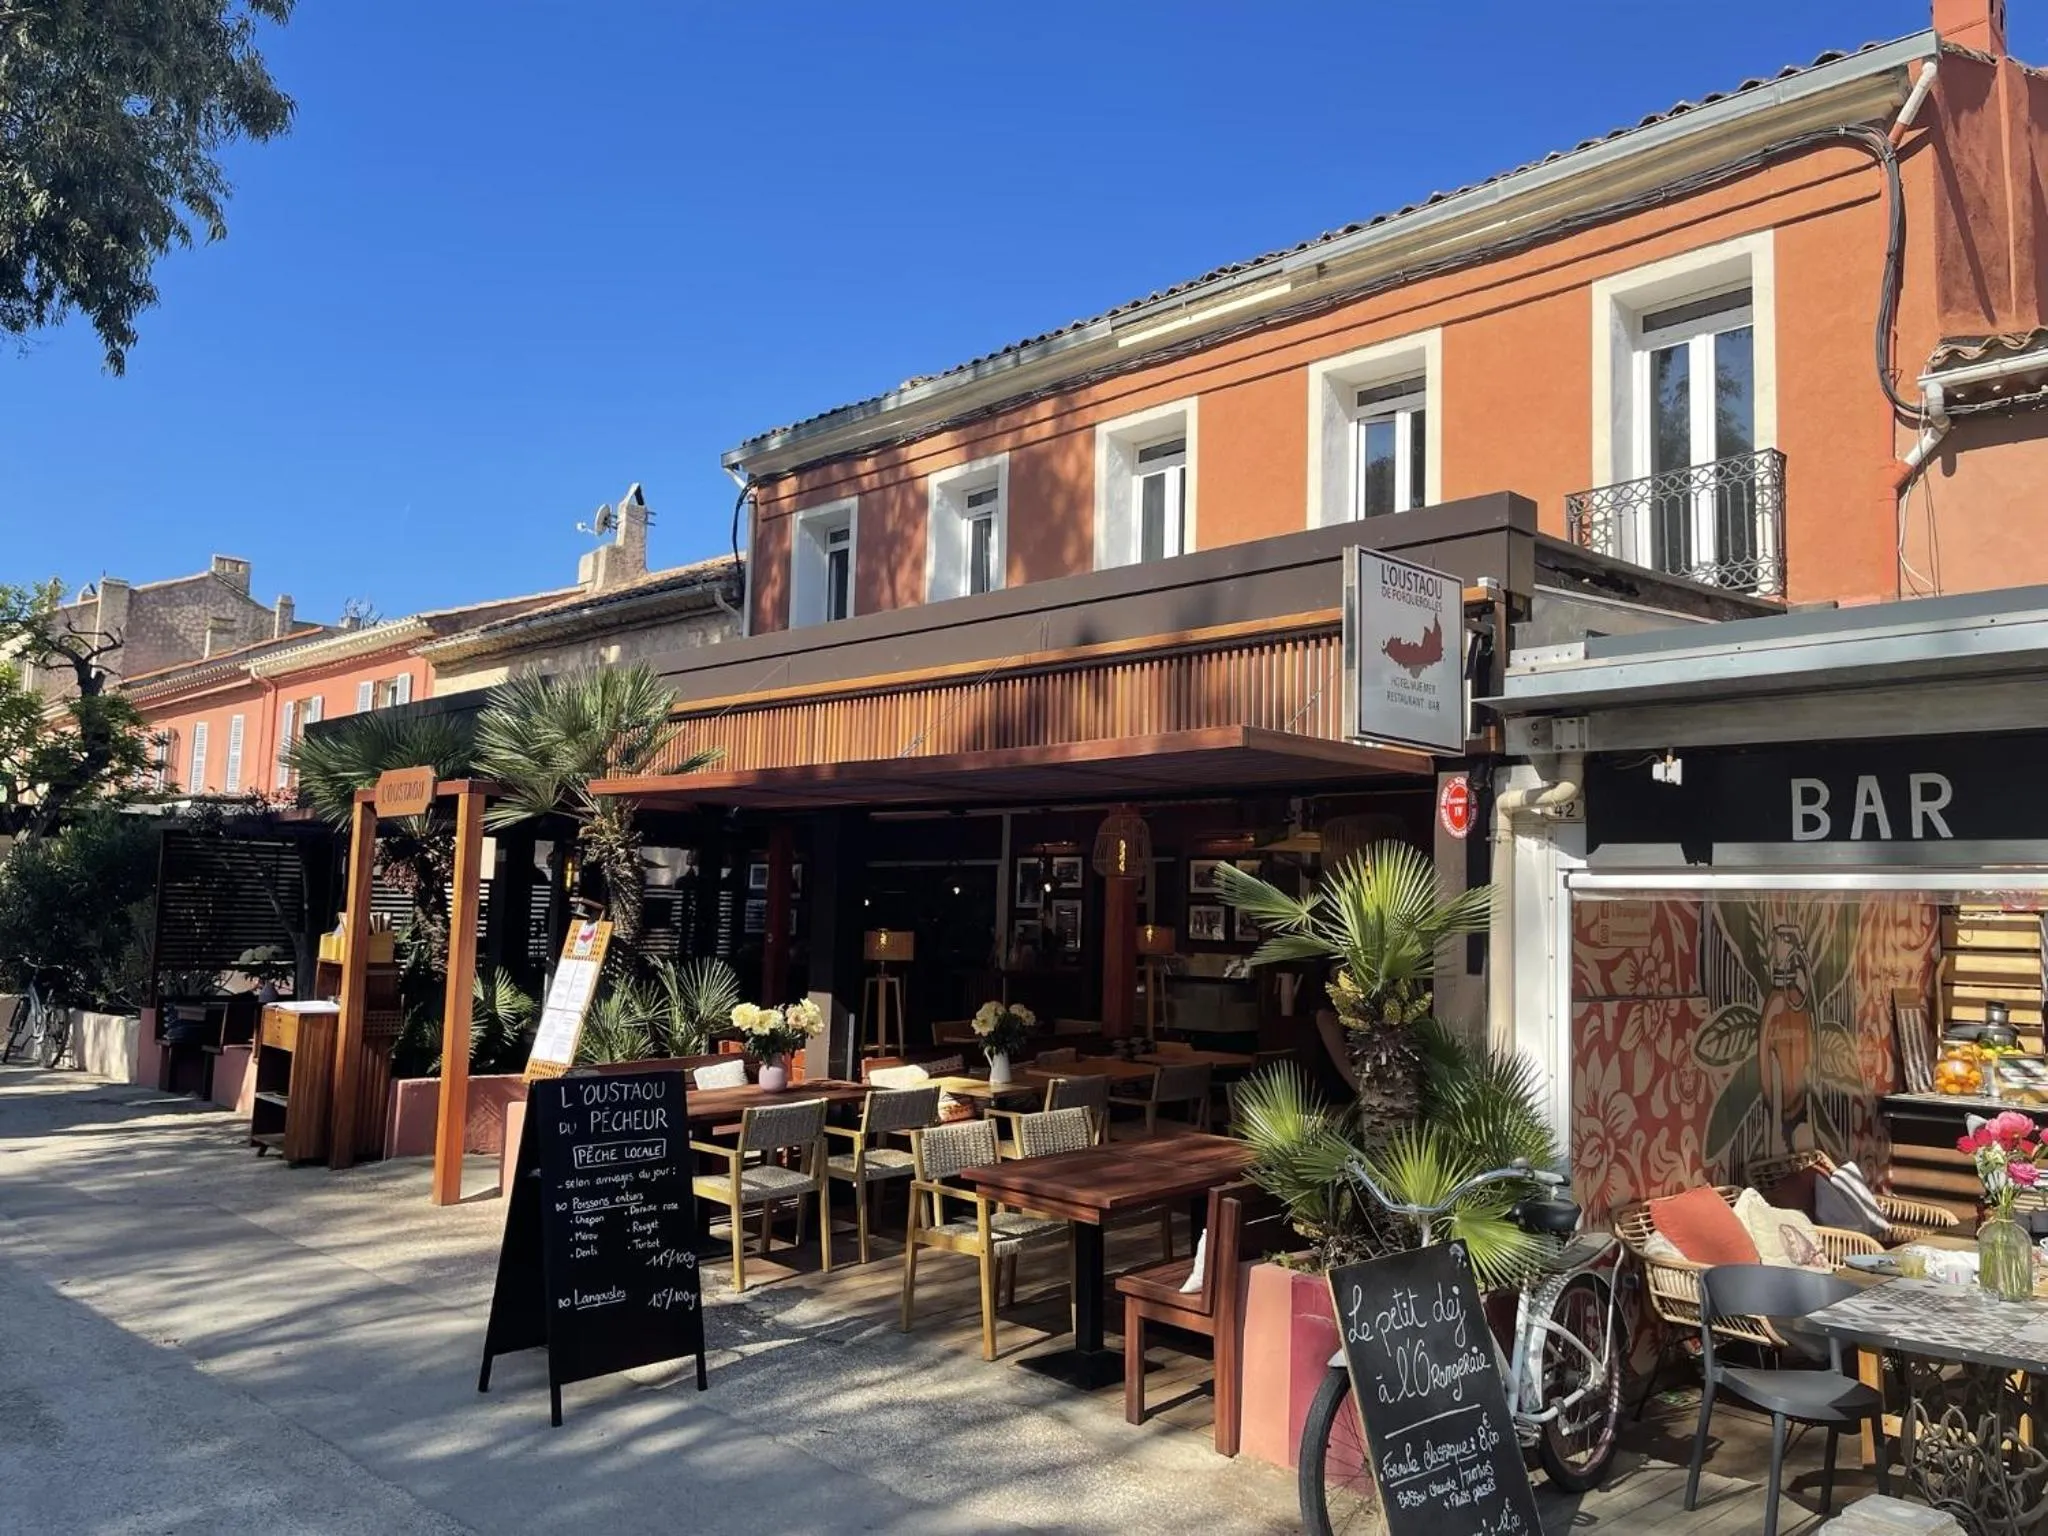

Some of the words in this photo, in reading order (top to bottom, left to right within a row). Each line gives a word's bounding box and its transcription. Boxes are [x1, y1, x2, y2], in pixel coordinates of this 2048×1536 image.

[1381, 563, 1443, 600] L'OUSTAOU
[1381, 585, 1392, 599] DE
[1386, 690, 1425, 709] RESTAURANT
[381, 780, 425, 805] L'OUSTAOU
[1554, 802, 1576, 818] 42
[1790, 772, 1954, 841] BAR
[560, 1080, 666, 1109] L'OUSTAOU
[558, 1121, 577, 1135] DU
[578, 1145, 617, 1164] PÊCHE
[624, 1144, 662, 1159] LOCALE
[565, 1178, 590, 1189] selon
[595, 1172, 634, 1189] arrivages
[572, 1197, 610, 1210] Poissons
[573, 1285, 626, 1306] Langoustes
[1348, 1284, 1374, 1343] Le
